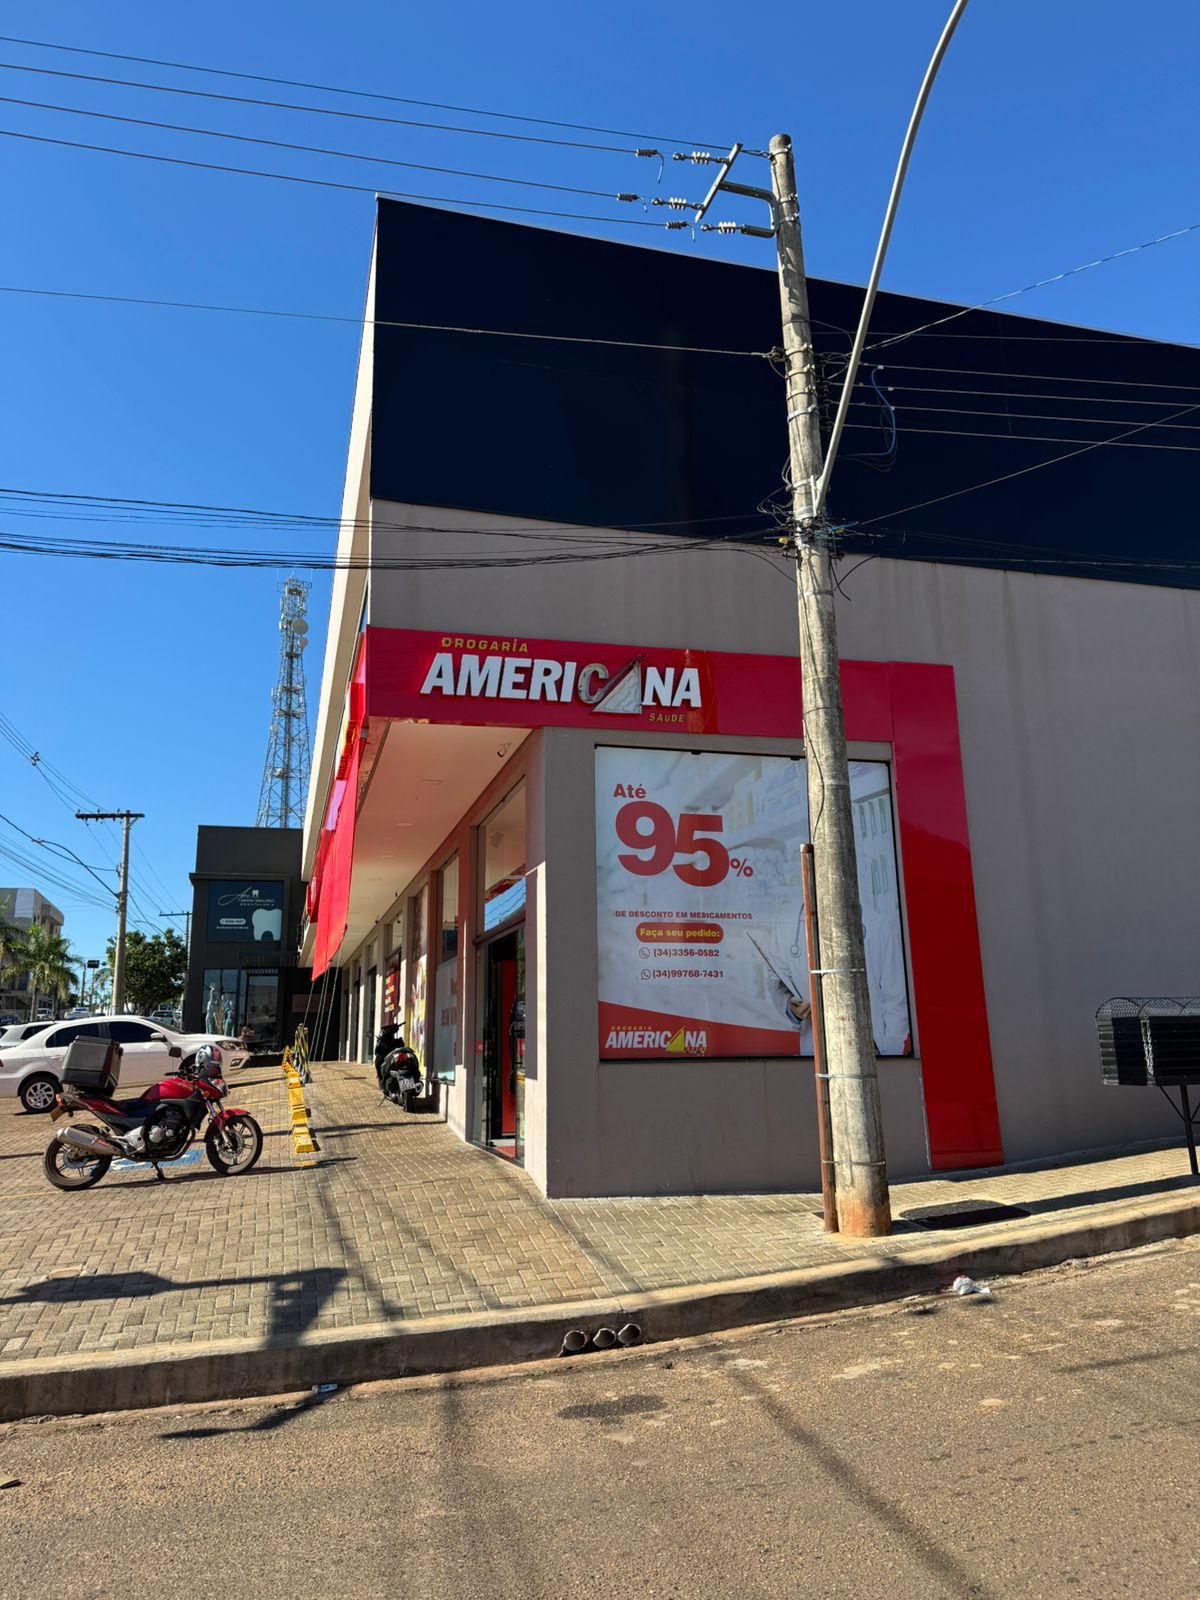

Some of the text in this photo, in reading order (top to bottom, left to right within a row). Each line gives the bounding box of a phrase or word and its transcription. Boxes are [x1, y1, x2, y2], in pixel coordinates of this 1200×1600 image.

[613, 783, 647, 799] Até
[615, 800, 754, 887] 95%
[615, 910, 753, 920] DE DESCONTO EM MEDICAMENTOS
[640, 928, 720, 939] Faça seu pedido:
